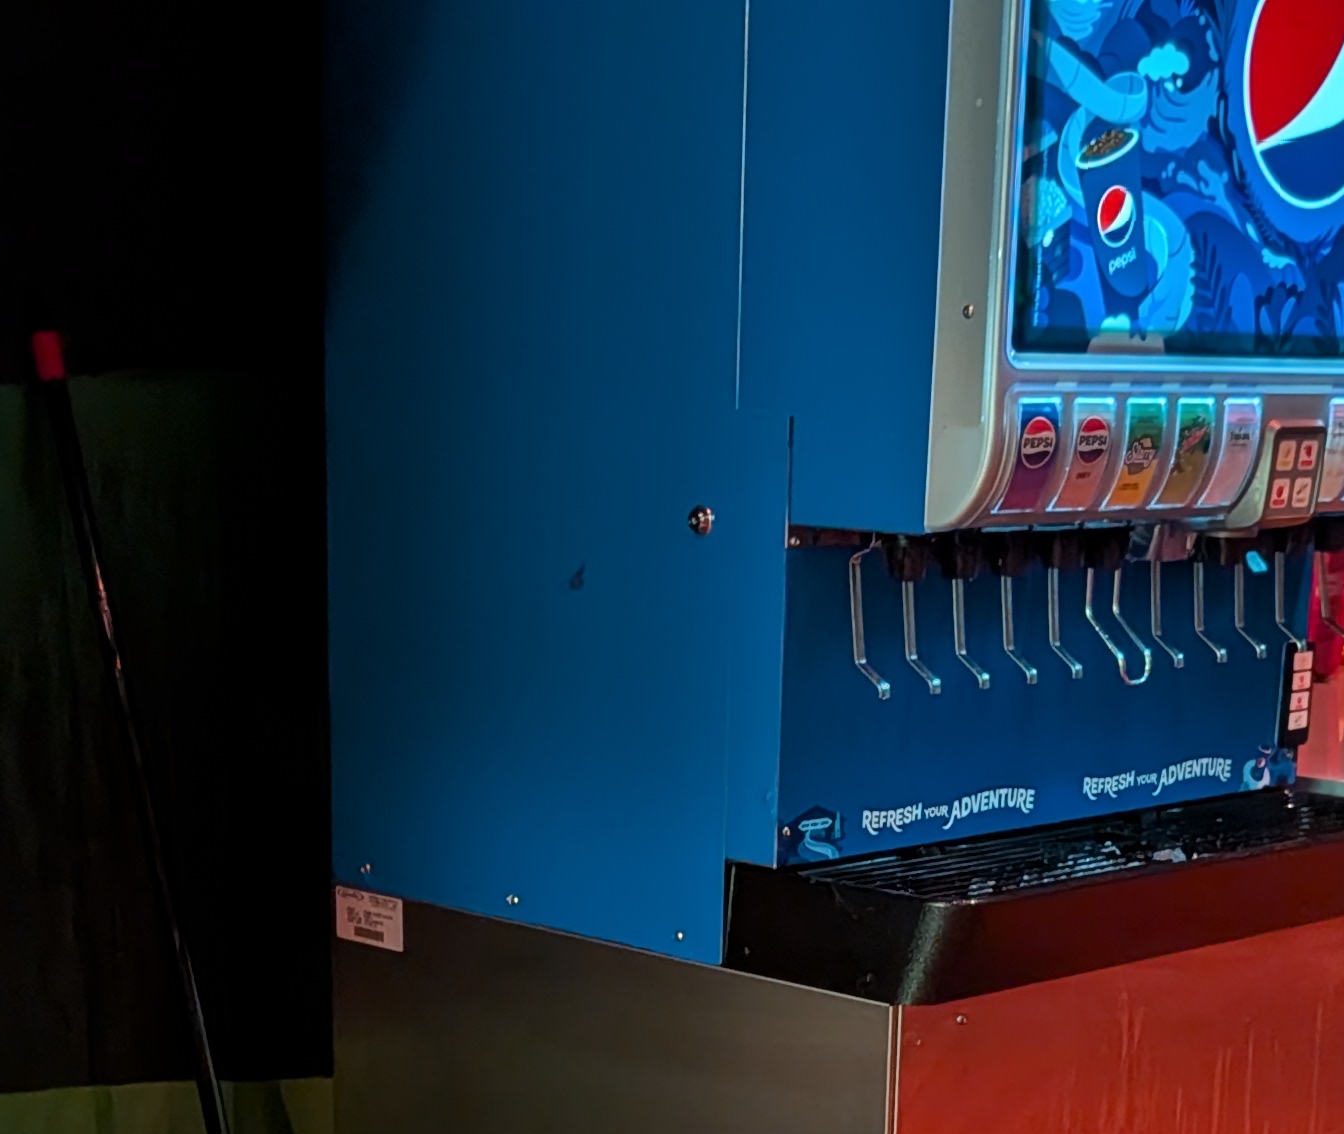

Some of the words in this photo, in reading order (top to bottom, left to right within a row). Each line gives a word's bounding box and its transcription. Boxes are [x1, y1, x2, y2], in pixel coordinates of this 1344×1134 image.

[1108, 246, 1138, 276] pepsi
[1023, 436, 1054, 449] PEPSI
[1079, 434, 1107, 447] PEPSI
[1083, 770, 1136, 801] REFRESH
[1136, 772, 1158, 786] YOUR
[1152, 757, 1233, 797] ADVENTURE
[862, 802, 923, 836] REFRESH
[924, 805, 949, 819] YOUR
[942, 788, 1036, 830] ADVENTURE
